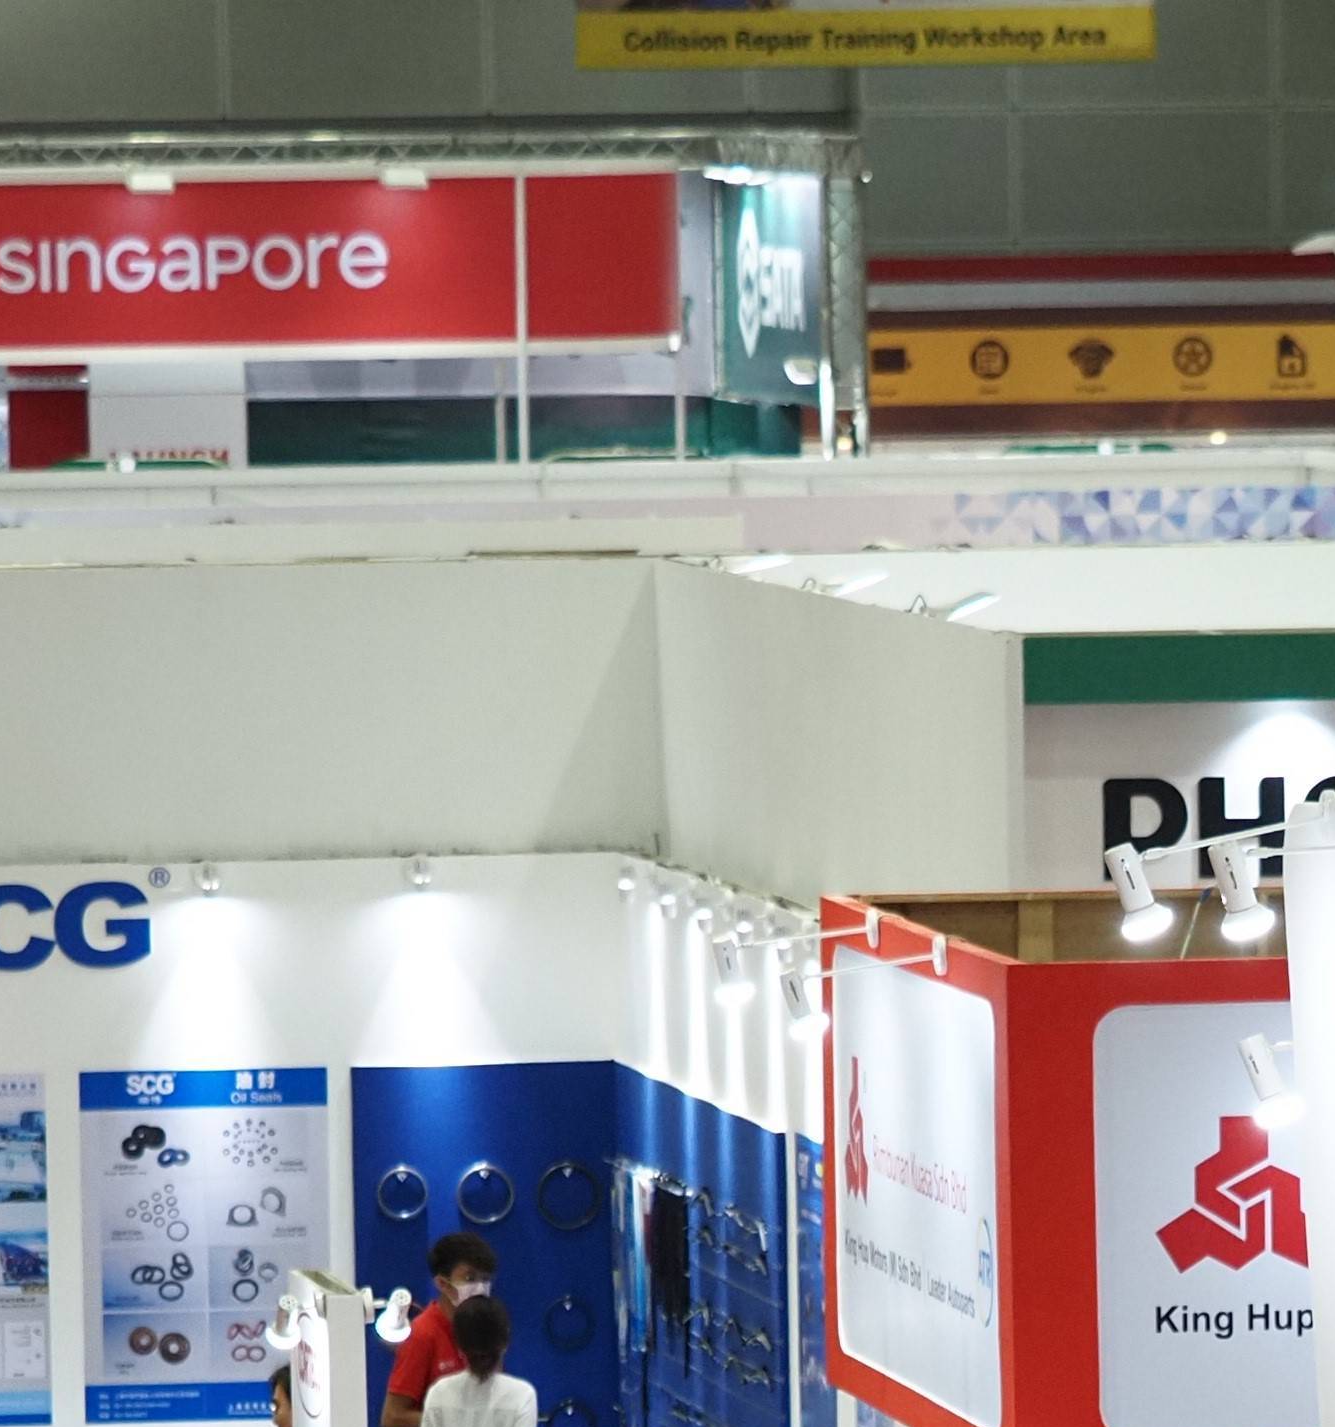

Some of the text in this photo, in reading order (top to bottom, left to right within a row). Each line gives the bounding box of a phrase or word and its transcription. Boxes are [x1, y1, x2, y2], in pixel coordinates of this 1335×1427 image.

[624, 26, 1105, 55] Collision Repair Training Workshop Area
[126, 1074, 175, 1095] SCG
[1155, 1303, 1314, 1339] King Hup
